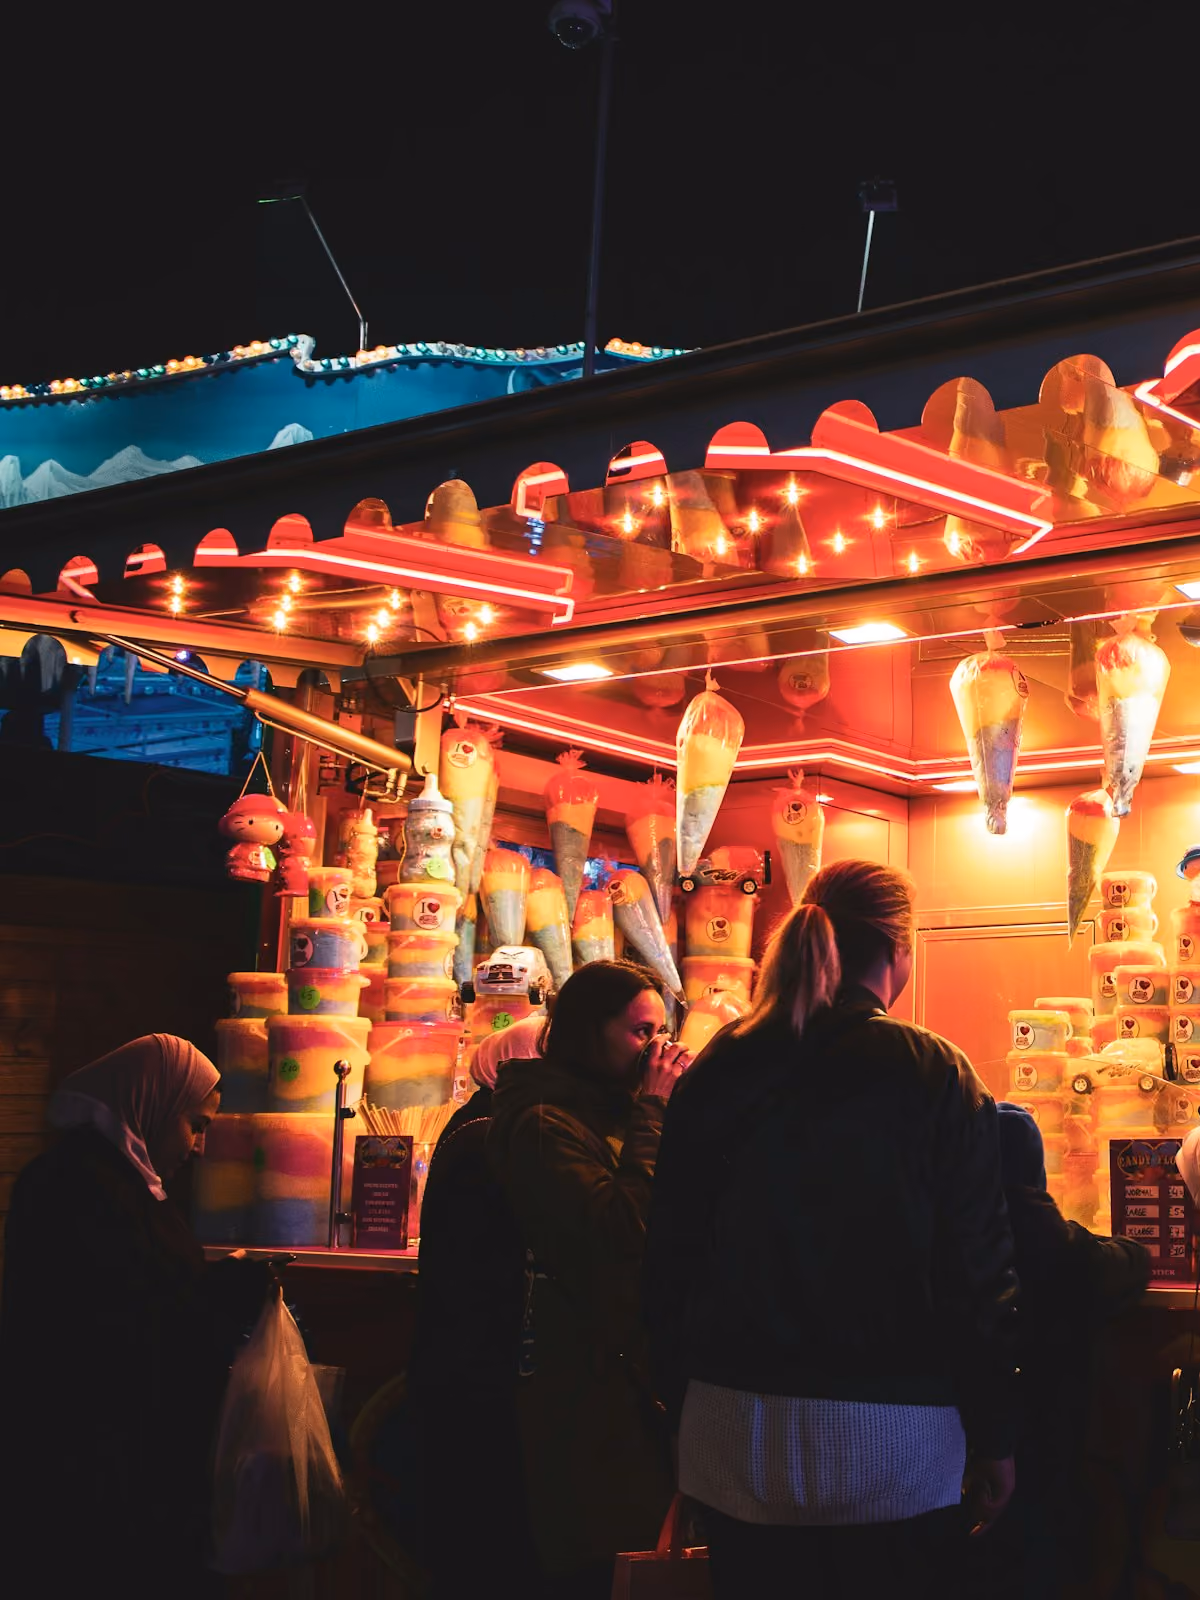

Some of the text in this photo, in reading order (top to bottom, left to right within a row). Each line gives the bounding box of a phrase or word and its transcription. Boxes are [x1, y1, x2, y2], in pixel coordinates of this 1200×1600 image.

[421, 902, 426, 913] I
[491, 1013, 513, 1029] £5
[1120, 1154, 1176, 1168] CANDY FLO
[1126, 1186, 1154, 1197] NORMAL
[1126, 1205, 1147, 1216] LARGE
[1127, 1226, 1155, 1237] XLARGE
